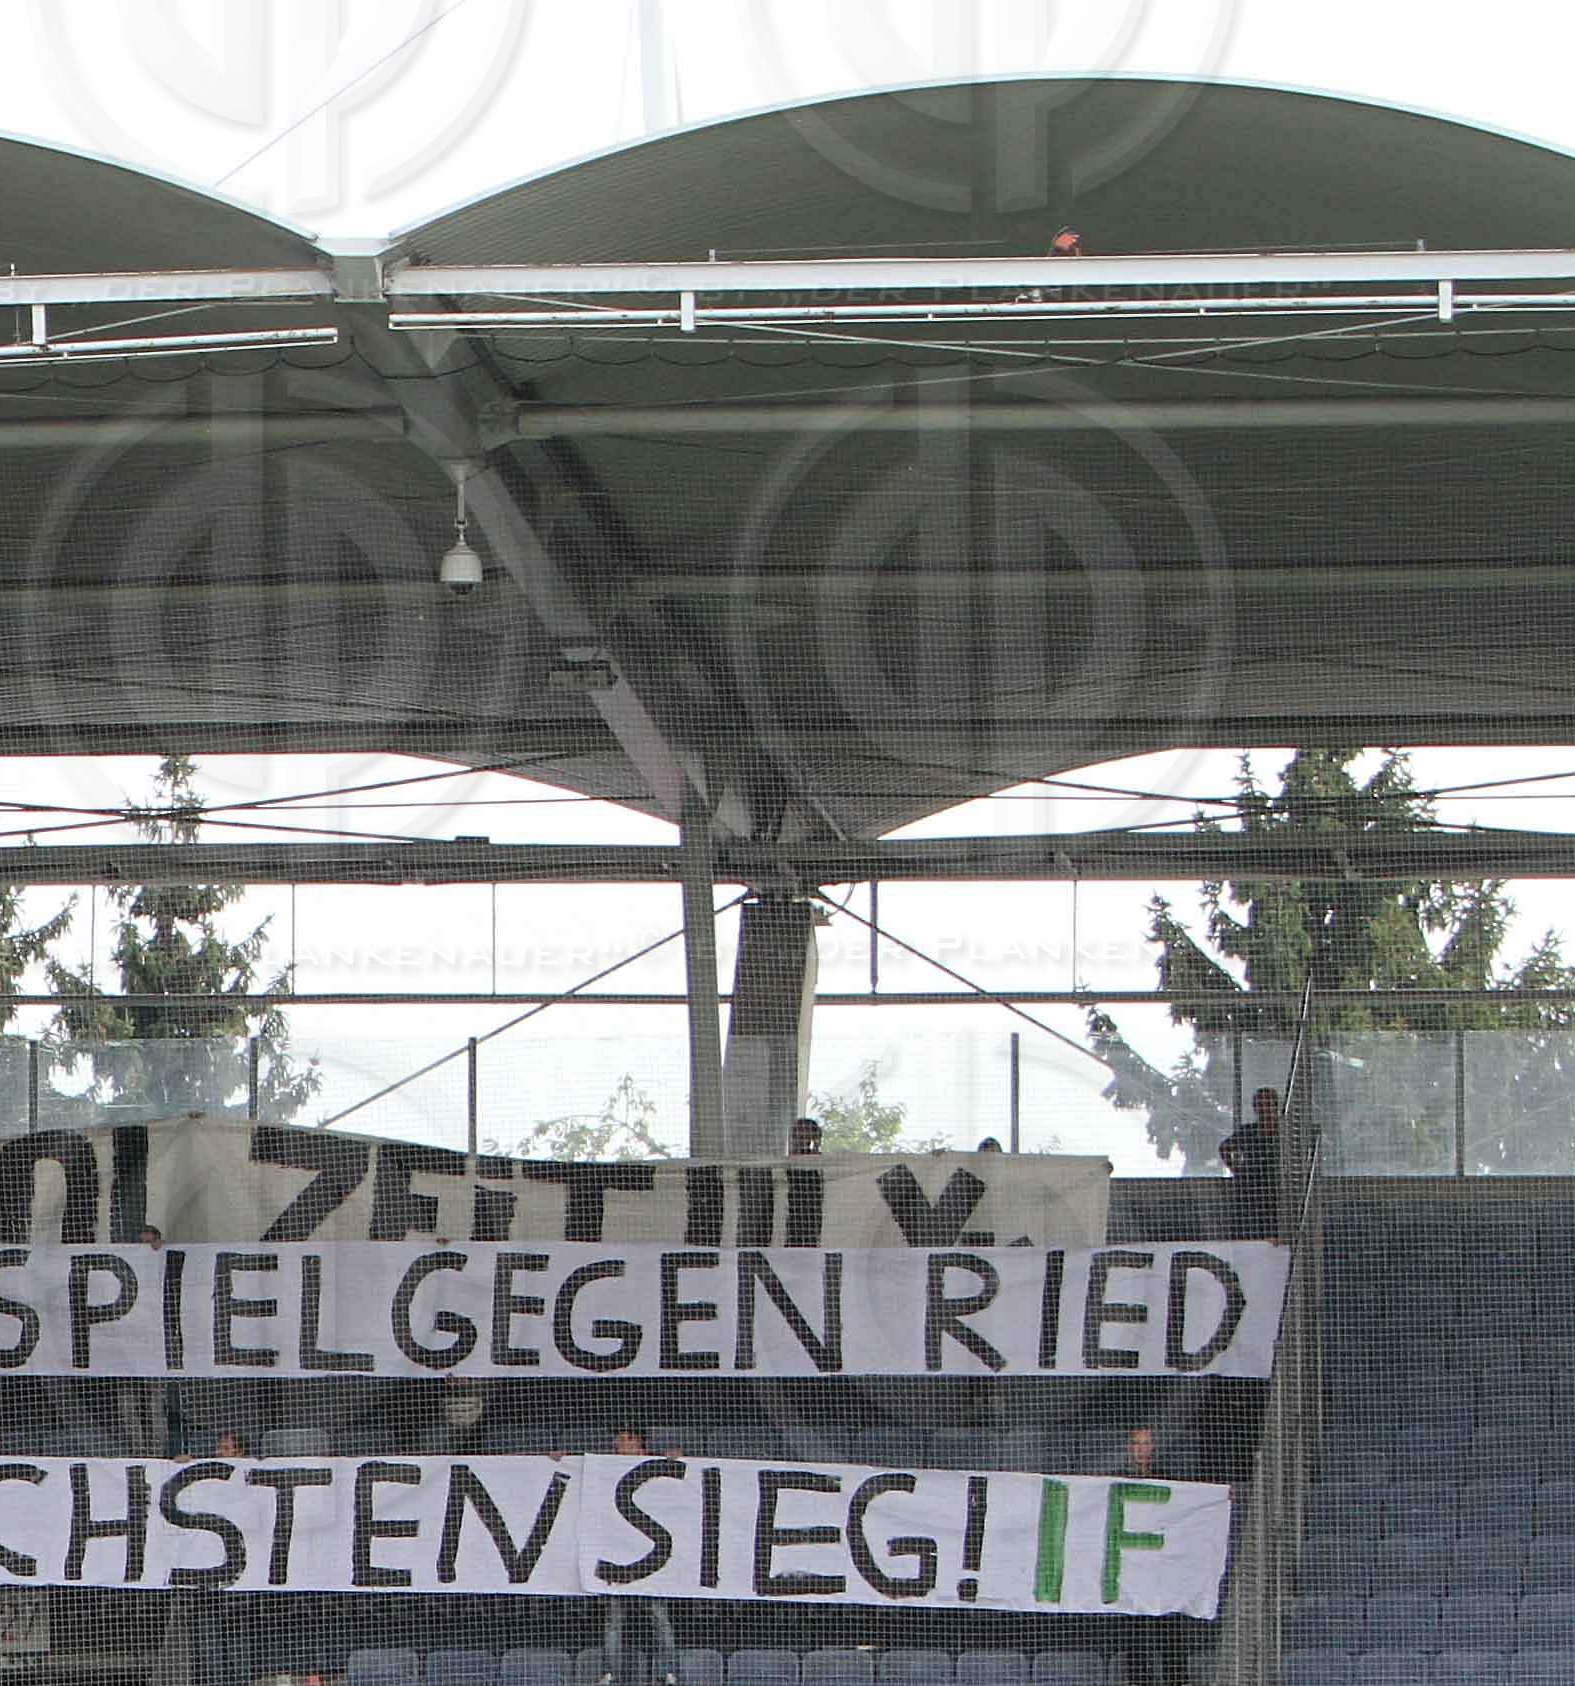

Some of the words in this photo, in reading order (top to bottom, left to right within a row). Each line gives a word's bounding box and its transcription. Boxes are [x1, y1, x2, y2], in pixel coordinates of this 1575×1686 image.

[391, 1249, 844, 1374] GEGEN
[925, 1249, 1248, 1374] RIED
[594, 1457, 988, 1603] SIEG!
[1033, 1477, 1173, 1606] IF
